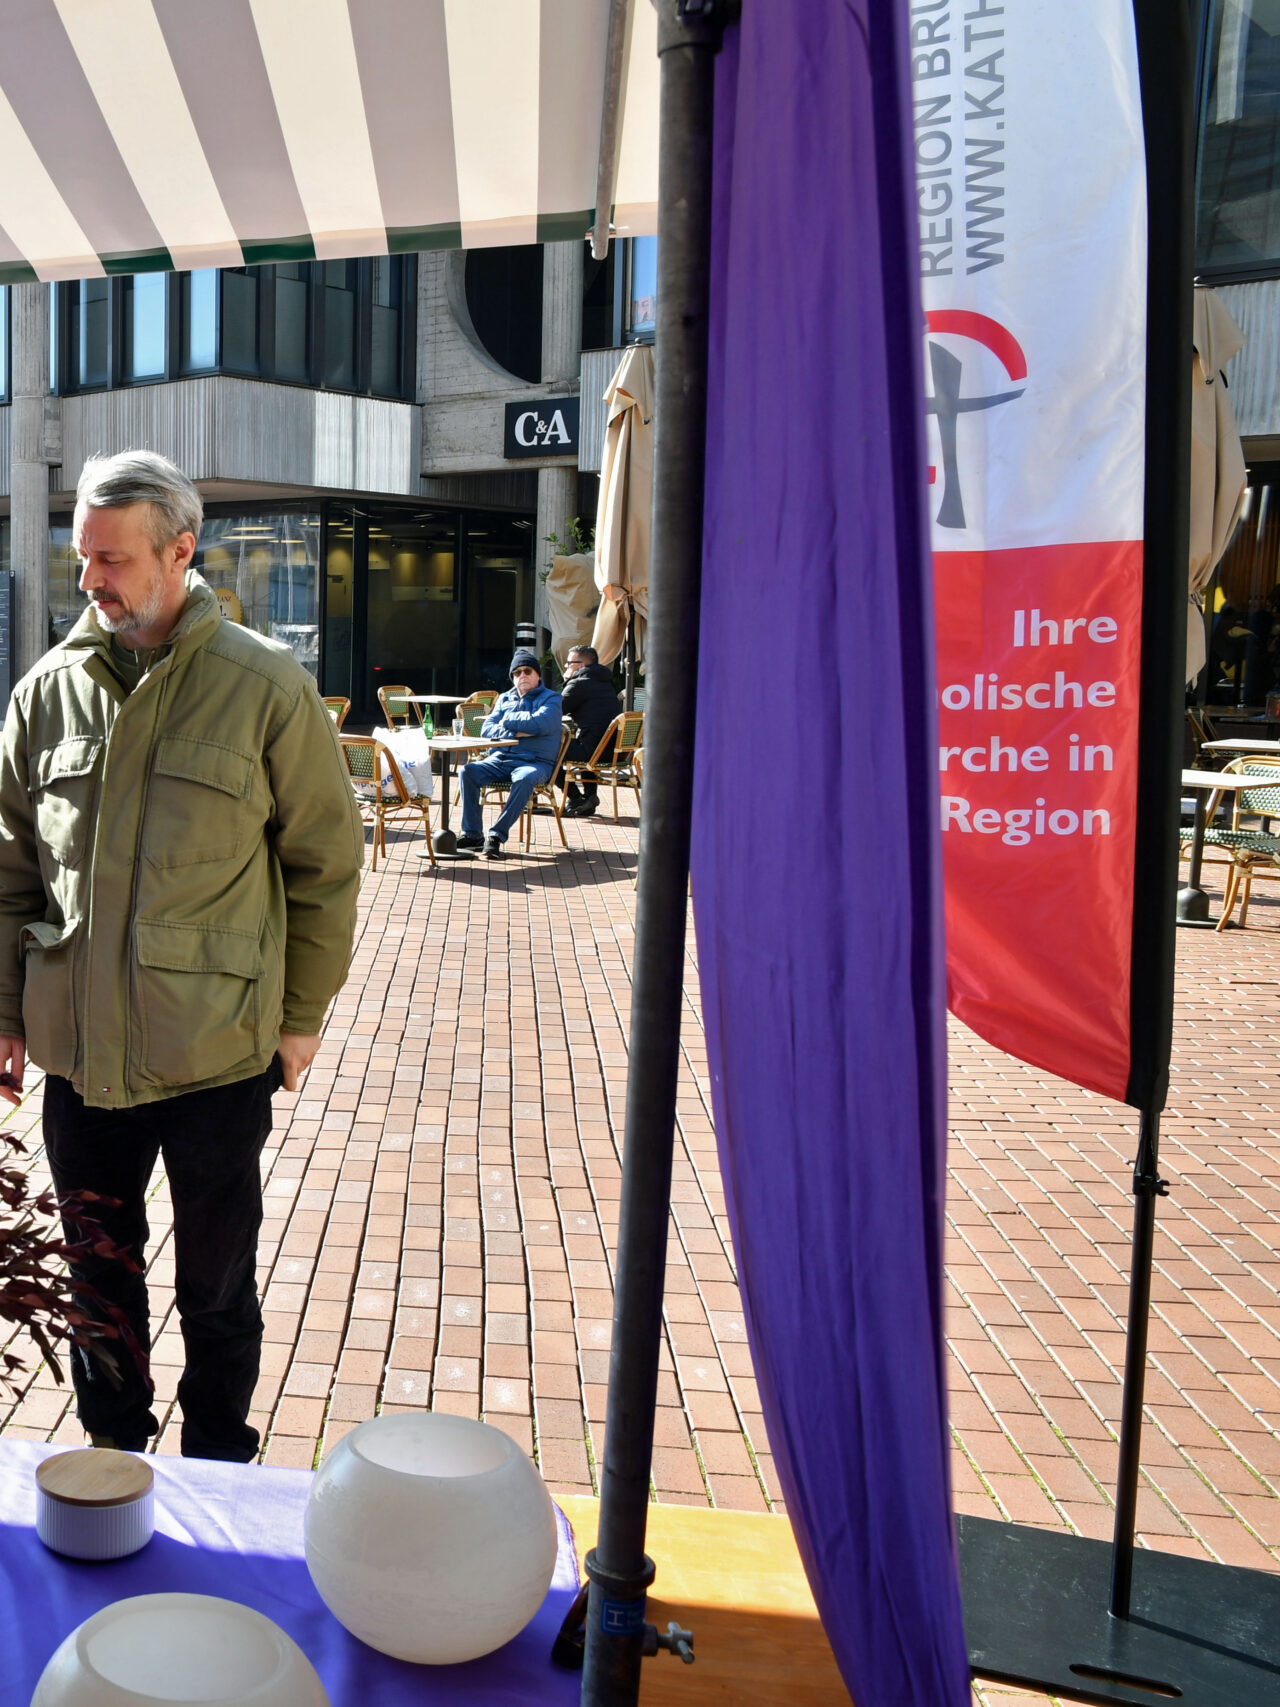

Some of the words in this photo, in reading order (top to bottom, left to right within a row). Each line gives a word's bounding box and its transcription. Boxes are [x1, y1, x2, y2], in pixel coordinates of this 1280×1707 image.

[914, 94, 953, 278] REGION
[514, 409, 572, 447] C&A
[1013, 609, 1118, 647] Ihre
[936, 671, 1116, 711] olische
[939, 735, 1050, 772] rche
[1069, 733, 1114, 772] in
[940, 795, 1111, 846] Region
